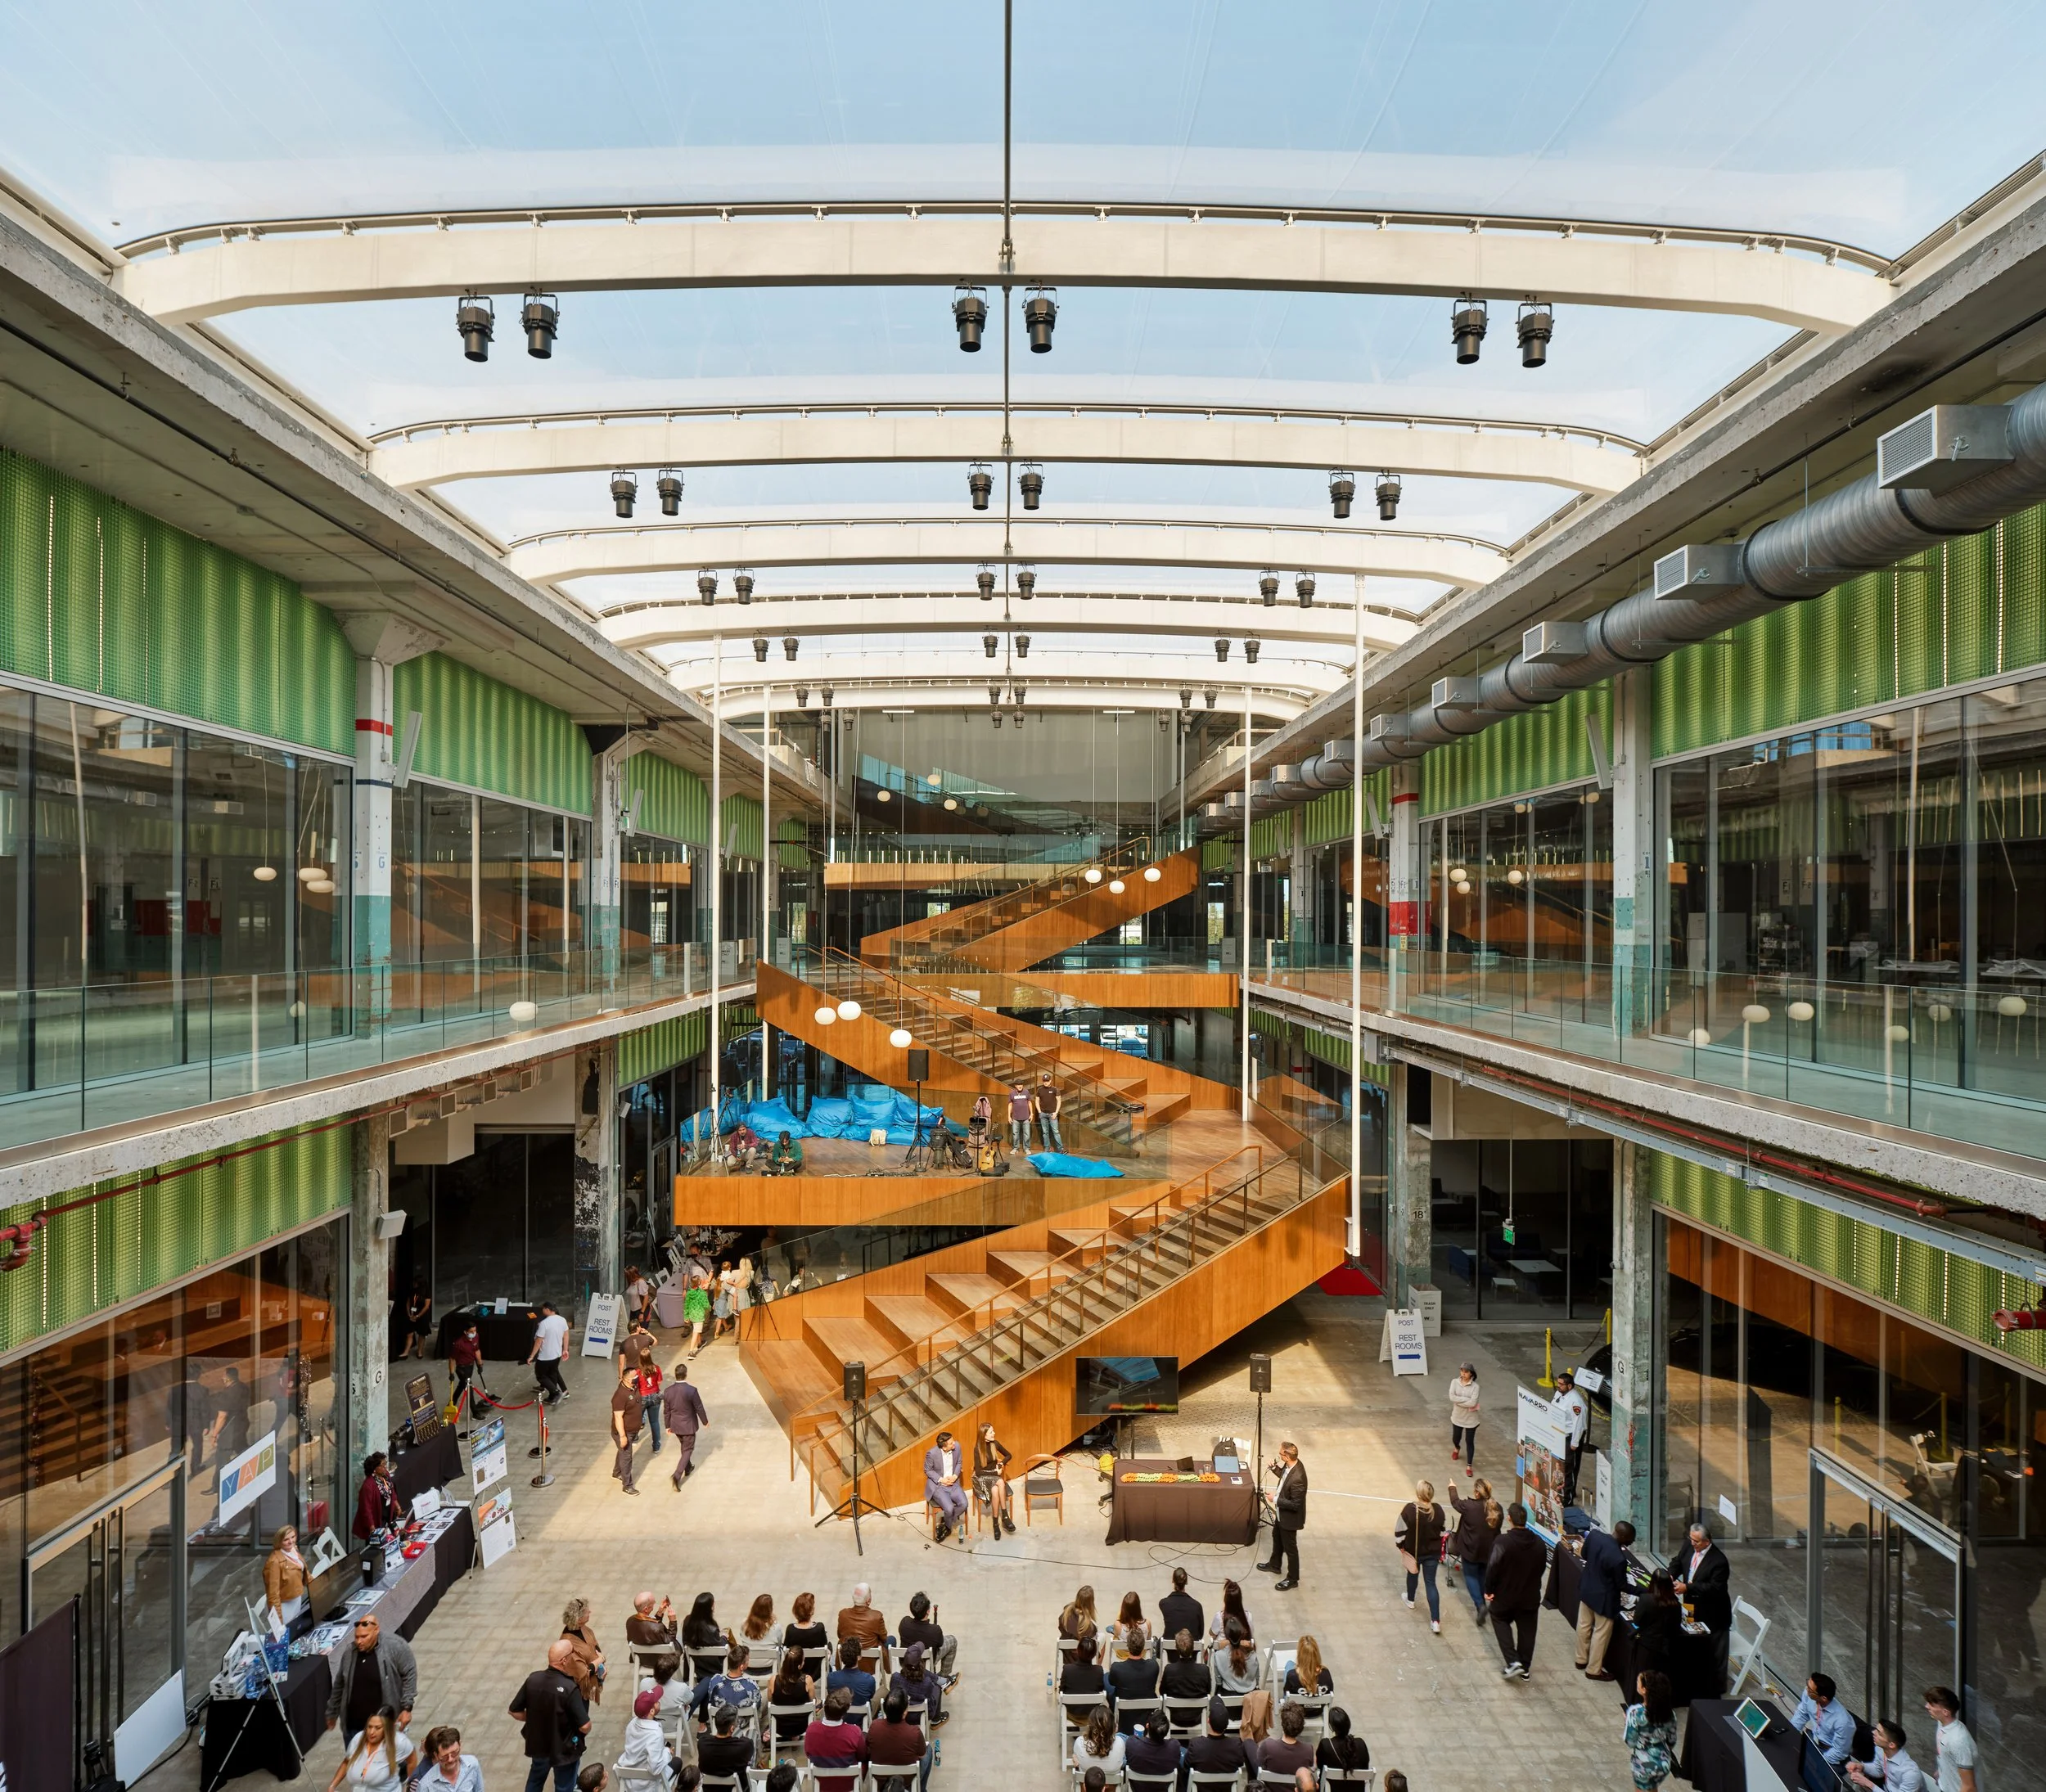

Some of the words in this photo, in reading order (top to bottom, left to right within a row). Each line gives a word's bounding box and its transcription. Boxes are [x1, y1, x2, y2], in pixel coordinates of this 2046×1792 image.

[378, 856, 385, 869] G
[1413, 1210, 1424, 1219] 18
[594, 1318, 611, 1326] REST
[588, 1326, 613, 1335] ROOMS
[1399, 1334, 1417, 1342] REST
[1617, 1360, 1625, 1375] G
[375, 1370, 382, 1385] G
[1518, 1391, 1548, 1412] NAVARRO
[224, 1447, 273, 1497] YAP
